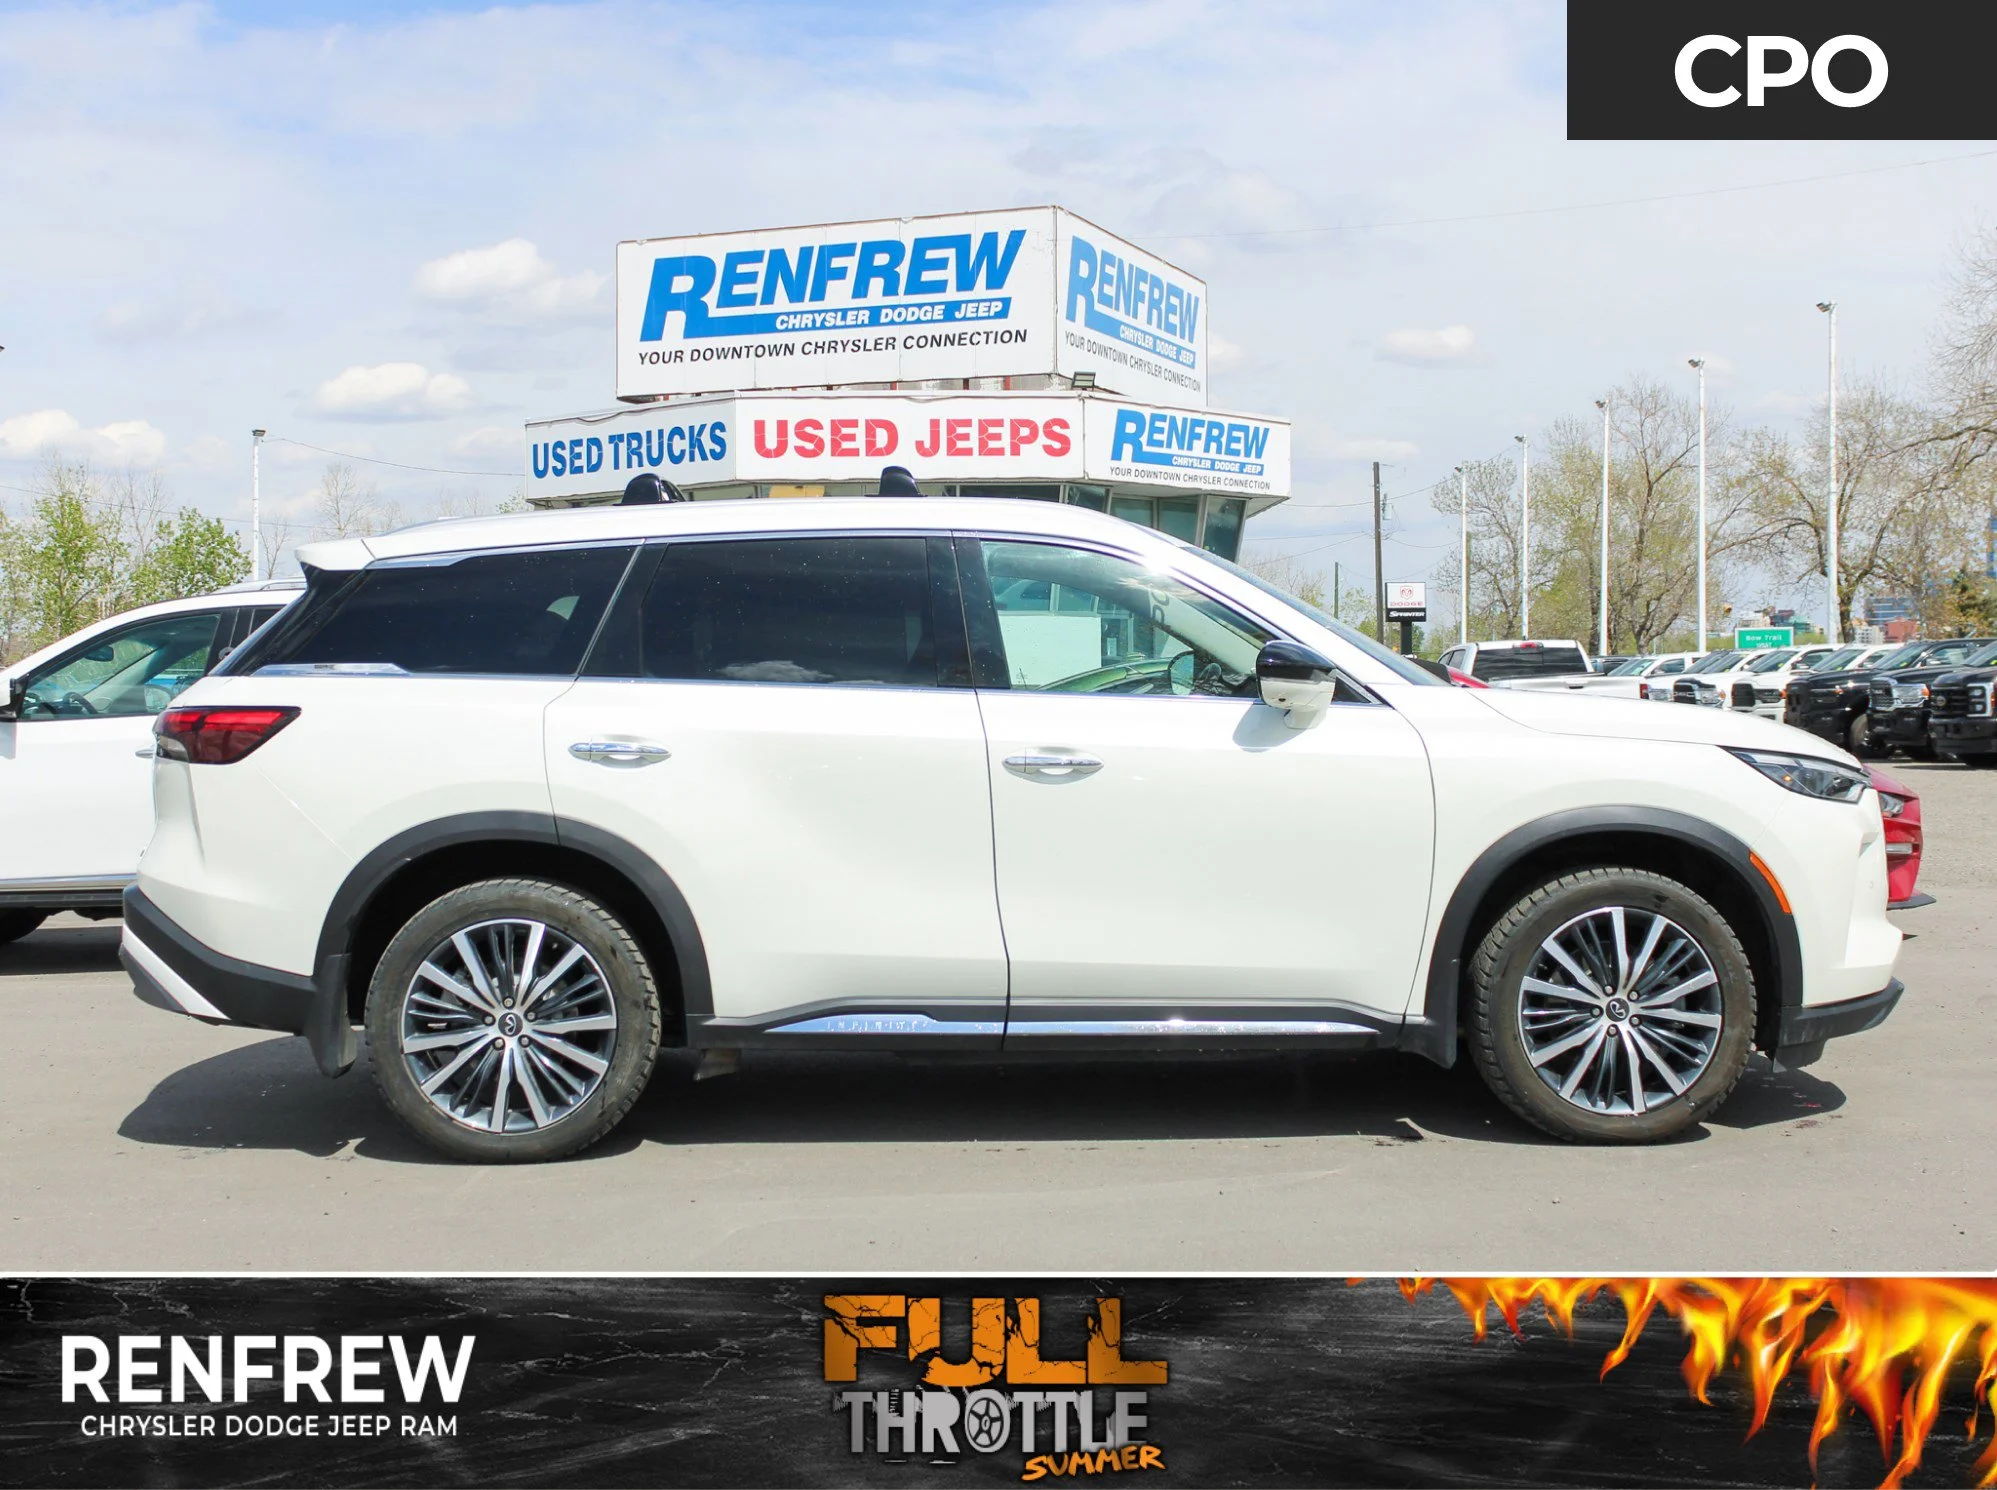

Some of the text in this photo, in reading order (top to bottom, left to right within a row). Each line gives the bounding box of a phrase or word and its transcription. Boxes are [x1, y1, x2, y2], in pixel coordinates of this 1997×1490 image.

[639, 229, 1027, 342] RENFREW
[1065, 234, 1200, 344] RENFREW
[776, 301, 1004, 331] CHRYSLER DODGE JEEP
[638, 328, 1028, 366] YOUR DOWNTOWN CHRYSLER CONNECTION
[1065, 331, 1201, 393] YOUR DOWNTOWN CHRYSLER CONNECTION
[1120, 325, 1194, 365] CHRYSLER DODGE JEEP
[532, 420, 728, 480] USED TRUCKS
[753, 416, 1072, 459] USED JEEPS
[1110, 409, 1270, 462] RENFREW
[1110, 466, 1271, 491] YOUR DOWNTOWN CHRYSLER CONNECTION
[1172, 456, 1262, 474] CHRYSLER DODGE JEEP
